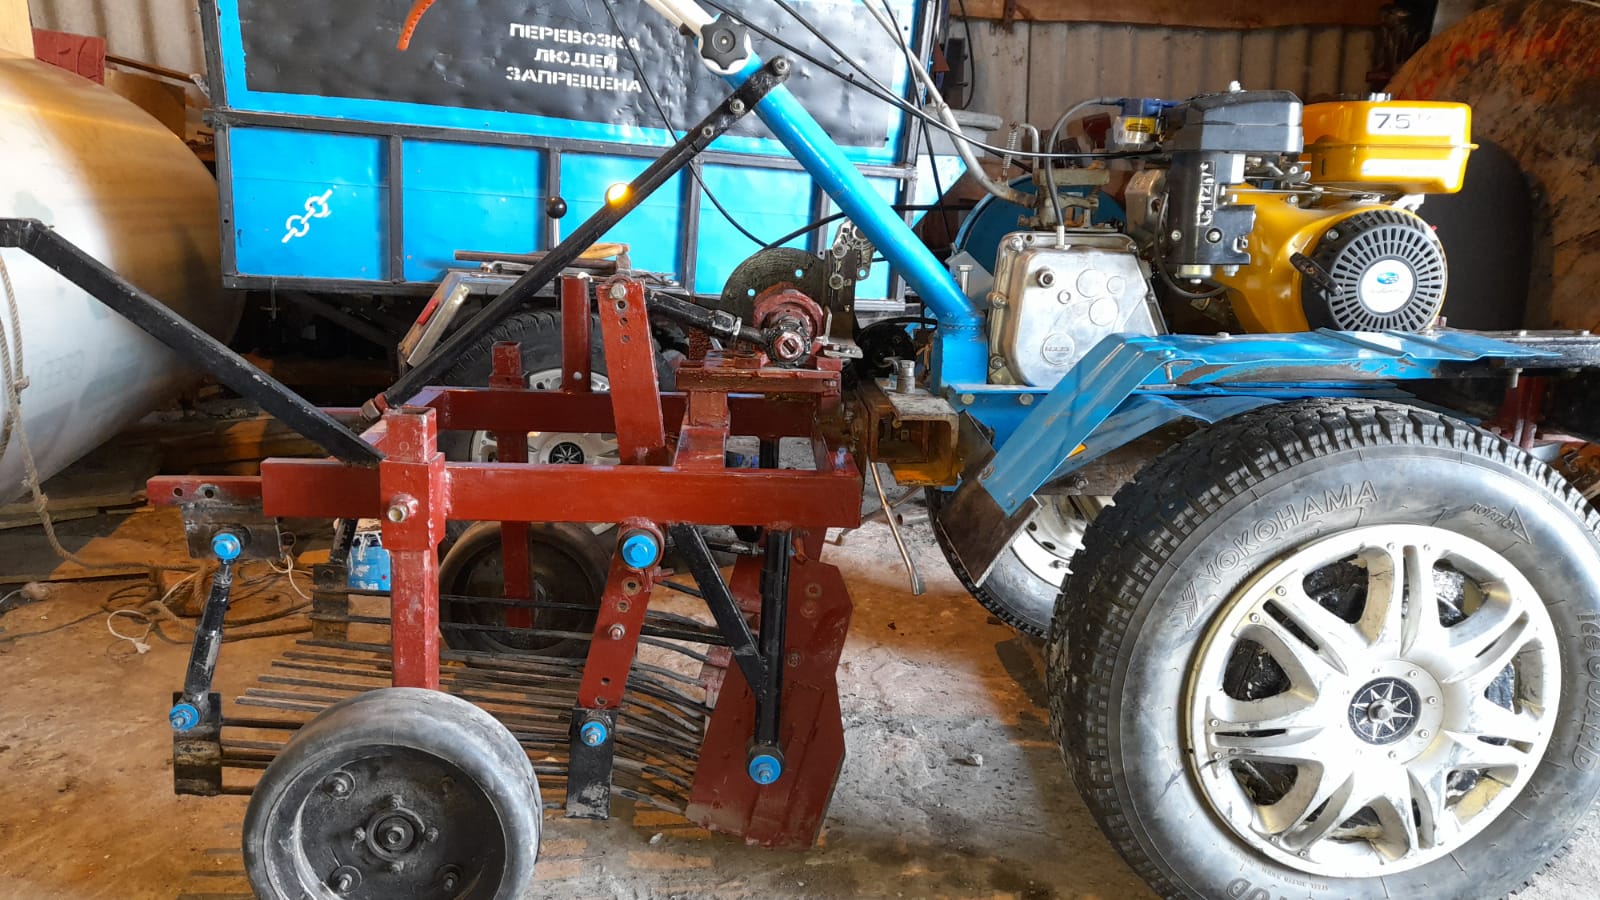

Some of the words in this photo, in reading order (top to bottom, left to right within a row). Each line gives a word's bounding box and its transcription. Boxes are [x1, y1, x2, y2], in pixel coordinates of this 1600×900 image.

[509, 22, 641, 51] ПЕРЕВОЗКА
[505, 66, 643, 94] ЗАПРЕЩЕНА
[1198, 479, 1379, 585] YOKOHAMA
